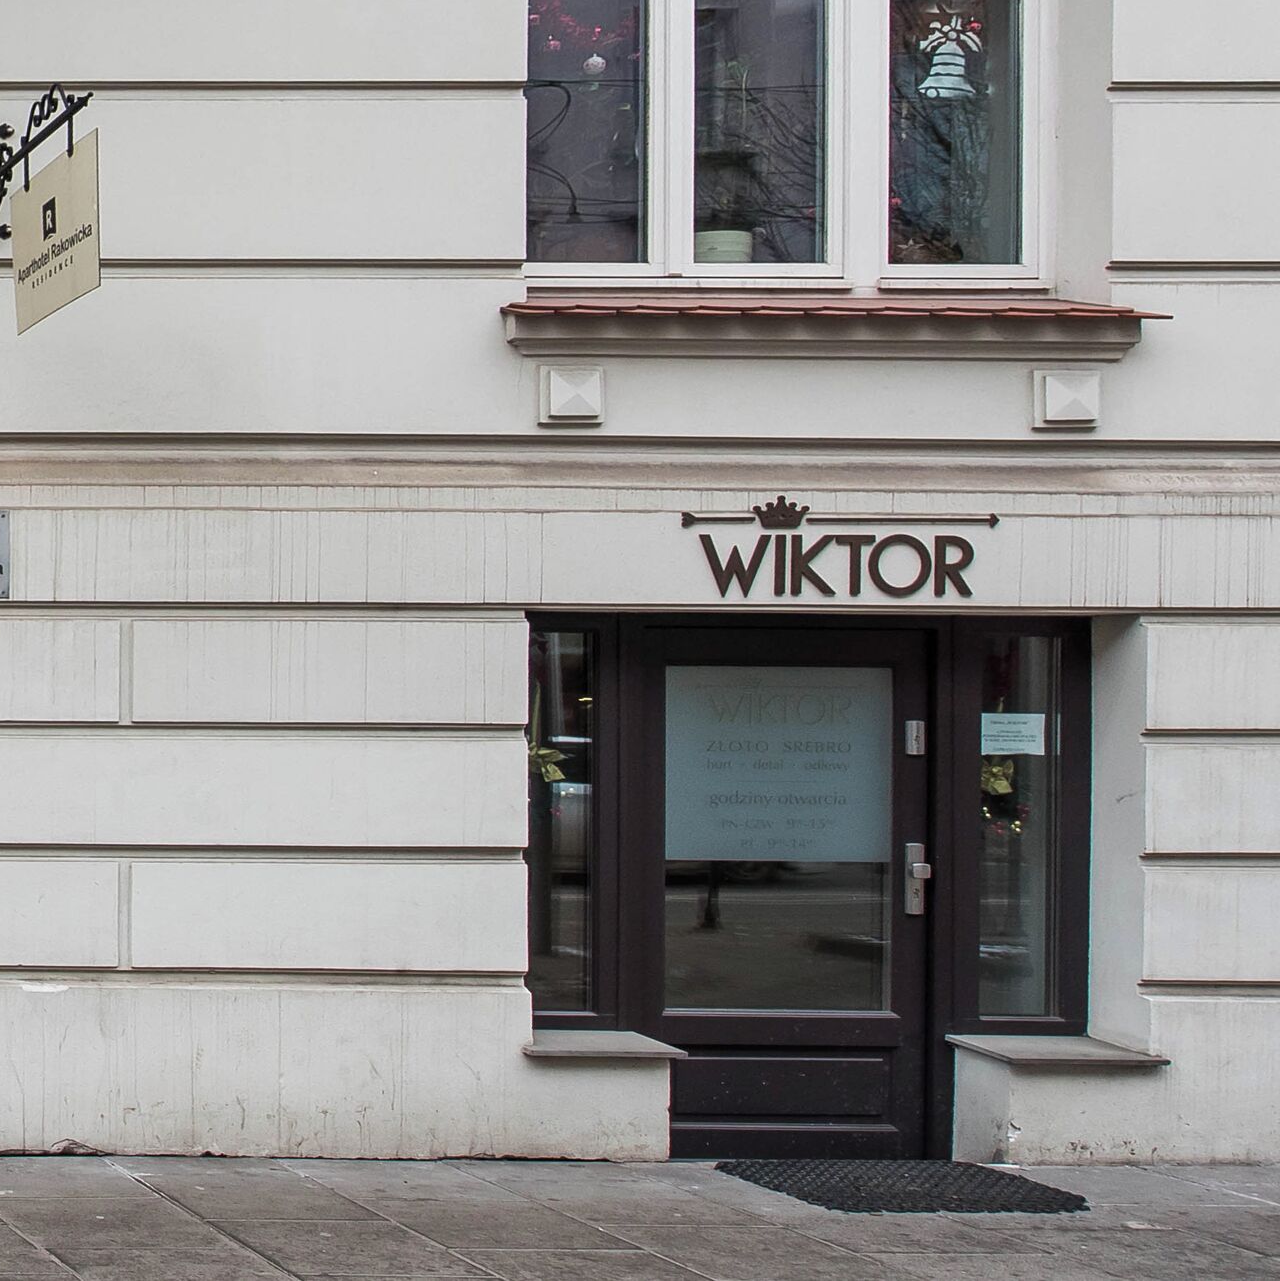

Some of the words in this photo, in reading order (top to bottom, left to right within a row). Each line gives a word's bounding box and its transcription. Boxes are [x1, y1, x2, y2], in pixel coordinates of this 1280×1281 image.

[45, 210, 53, 230] R
[17, 250, 50, 284] Aparthotel
[51, 223, 93, 260] Rakowicka
[32, 256, 74, 289] RESIDENCE
[698, 533, 975, 598] WIKTOR
[706, 740, 769, 752] ZŁOTO
[783, 740, 851, 752] SREBRO
[709, 791, 772, 807] godziny
[778, 792, 847, 806] otwarcia
